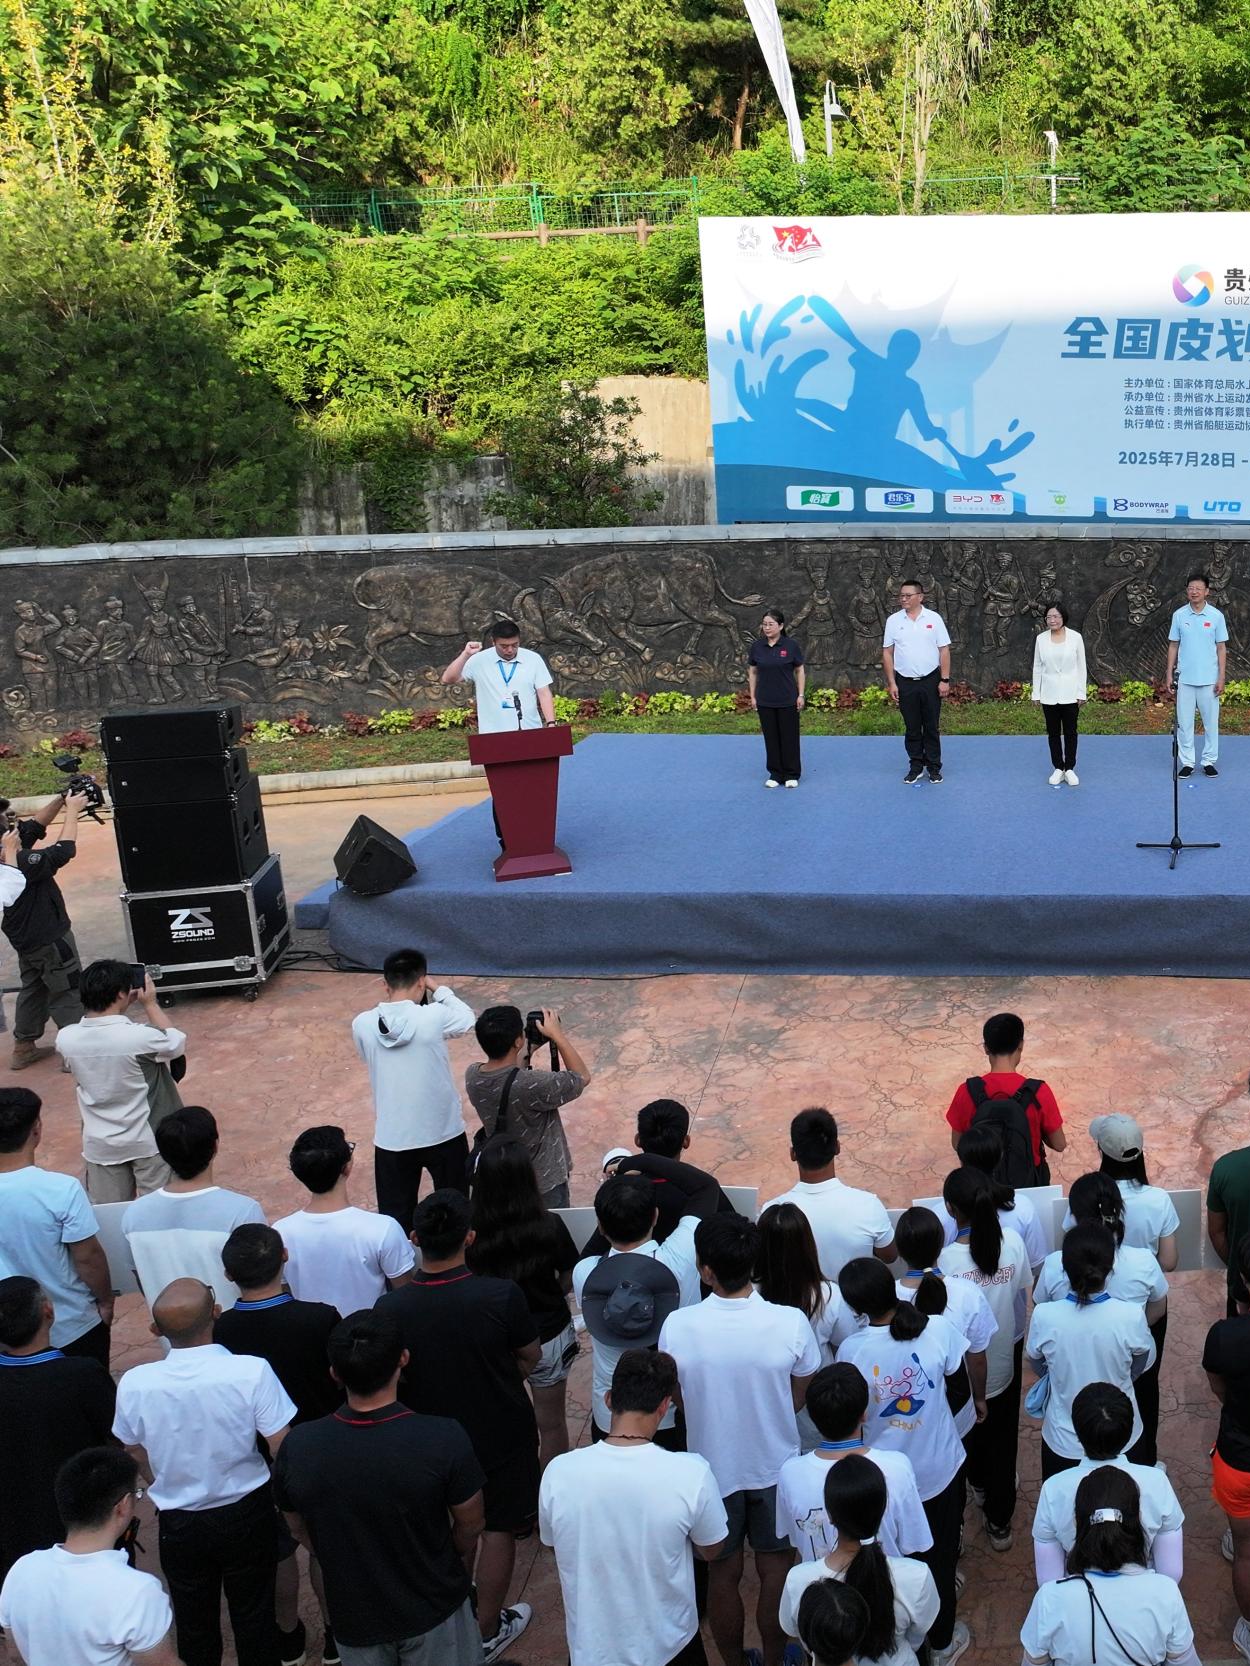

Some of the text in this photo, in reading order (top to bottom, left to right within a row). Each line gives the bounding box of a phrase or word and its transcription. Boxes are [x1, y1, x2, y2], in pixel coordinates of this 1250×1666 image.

[1129, 501, 1169, 509] BODYWRAP
[1203, 501, 1242, 512] UTO
[171, 928, 215, 939] ZSOUND
